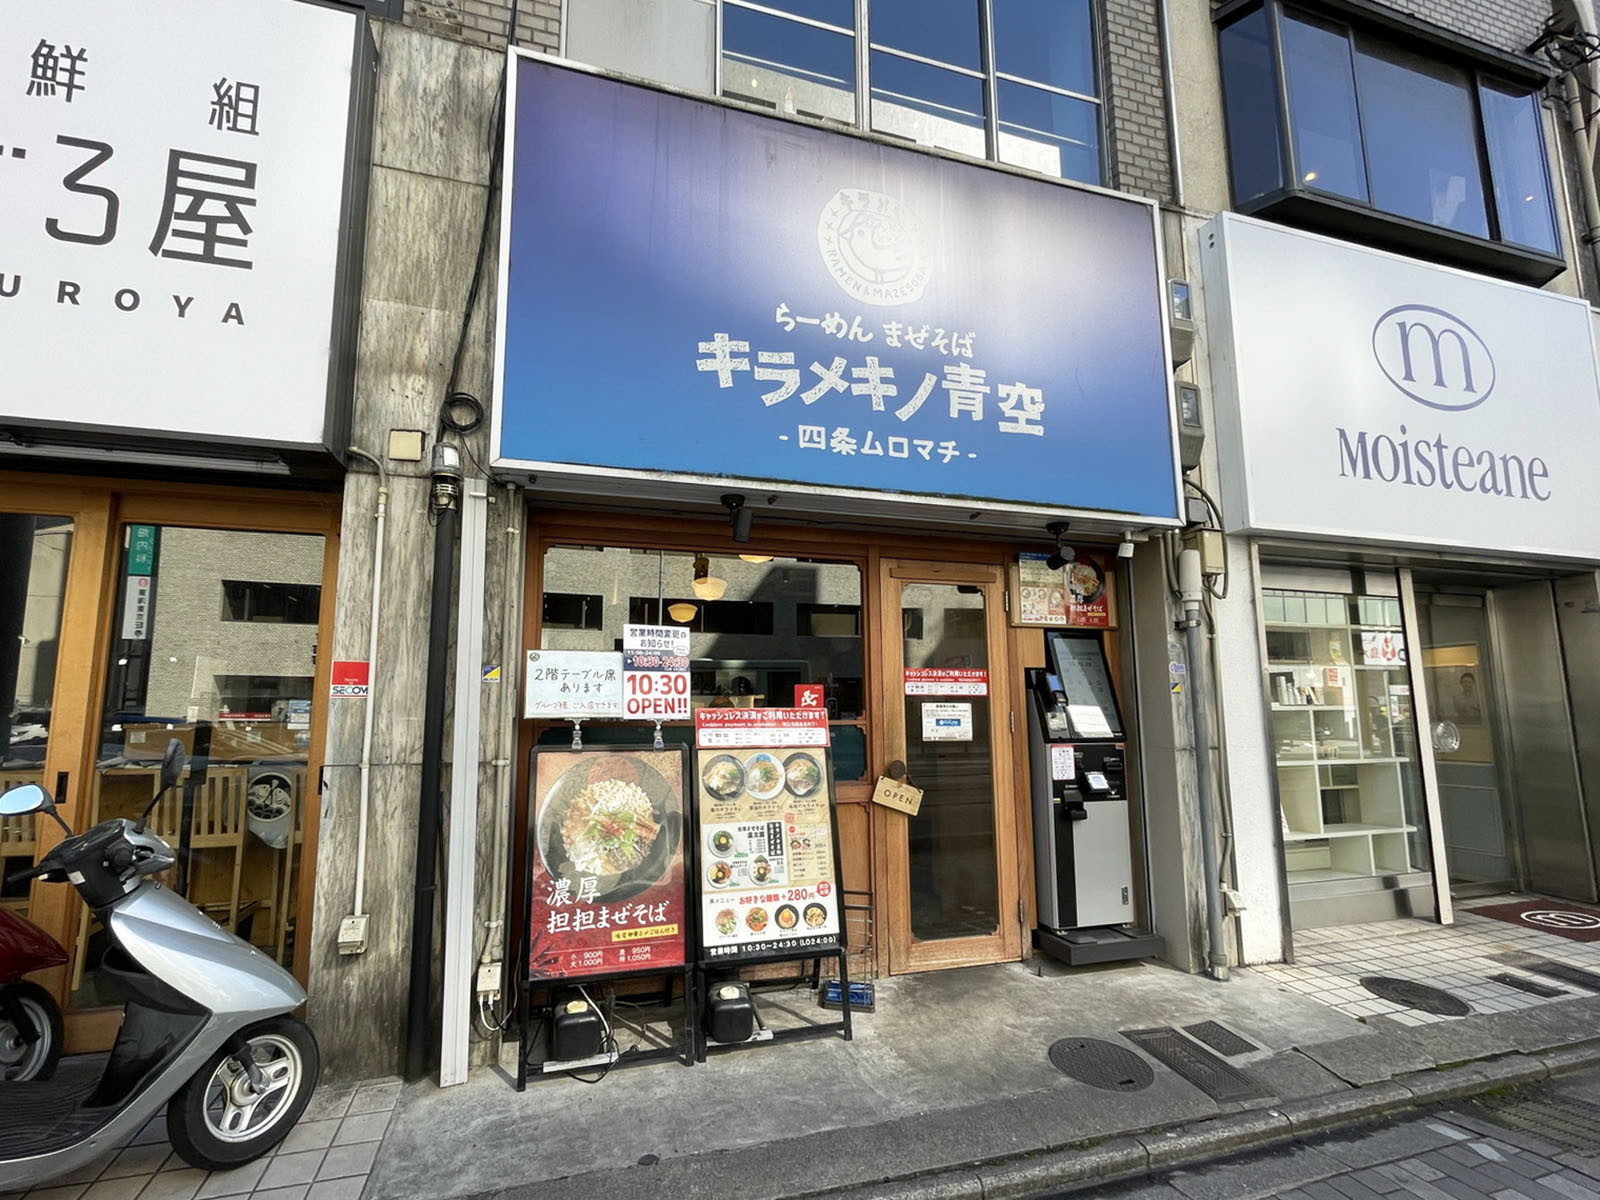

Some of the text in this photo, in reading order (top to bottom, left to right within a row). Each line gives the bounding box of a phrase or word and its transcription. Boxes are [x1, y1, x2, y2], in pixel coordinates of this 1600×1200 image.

[0, 134, 258, 270] ろ屋
[775, 303, 977, 359] らーめん まぜそば
[696, 332, 1046, 437] キラメキノ青空
[533, 667, 617, 682] 2階テーブル席
[626, 674, 688, 696] 10:30
[559, 683, 603, 694] あります
[626, 697, 688, 715] OPEN!!
[883, 788, 914, 806] OPEN
[546, 876, 601, 908] 濃厚
[546, 900, 670, 935] 担担まぜそば
